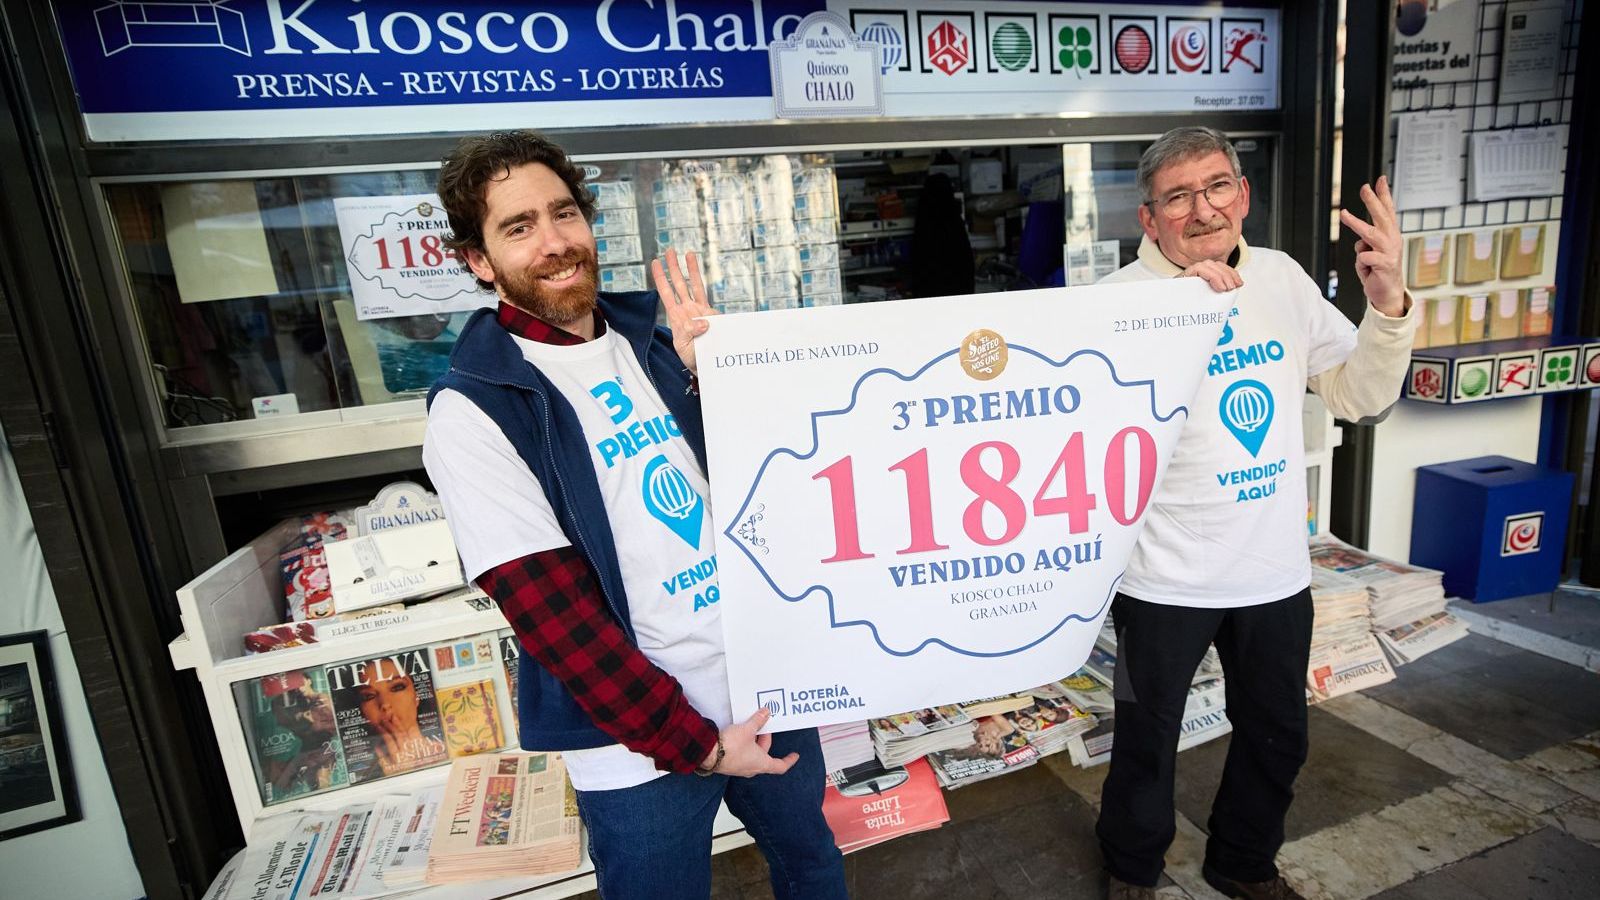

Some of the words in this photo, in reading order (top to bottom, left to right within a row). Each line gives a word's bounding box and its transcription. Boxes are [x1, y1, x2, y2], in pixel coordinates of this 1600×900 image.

[264, 0, 569, 55] Kiosco
[1394, 40, 1439, 55] oterías
[806, 59, 849, 79] Quiosco
[1393, 57, 1446, 76] puestas
[1449, 53, 1470, 69] del
[234, 72, 379, 99] PRENSA
[402, 68, 556, 96] REVISTAS
[579, 62, 724, 92] LOTERÍAS
[805, 81, 855, 102] CHALO
[407, 219, 449, 231] PREMI
[372, 235, 458, 270] 118
[400, 268, 444, 278] VENDIDO
[1114, 320, 1129, 333] 22
[1132, 317, 1150, 331] DE
[1153, 311, 1224, 329] DICIEMBRE
[715, 347, 781, 368] LOTERÍA
[785, 348, 805, 362] DE
[808, 342, 879, 361] NAVIDAD
[1208, 339, 1285, 377] REMIO
[923, 384, 1081, 428] PREMIO
[1216, 458, 1287, 488] VENDIDO
[811, 426, 1158, 564] 11840
[1235, 478, 1277, 503] AQUÍ
[888, 552, 1026, 588] VENDIDO
[1033, 533, 1103, 573] AQUÍ
[662, 555, 718, 596] VENDI
[693, 585, 720, 613] AQ
[951, 587, 1004, 605] KIOSCO
[1006, 580, 1054, 598] CHALO
[969, 600, 1038, 621] GRANADA
[331, 625, 359, 637] ELIGE
[361, 621, 376, 632] TU
[375, 615, 410, 629] REGALO
[326, 649, 431, 692] TELVA
[790, 684, 850, 702] LOTERÍA
[791, 696, 866, 715] NACIONAL
[862, 795, 901, 814] Libre
[864, 812, 904, 830] Tinta
